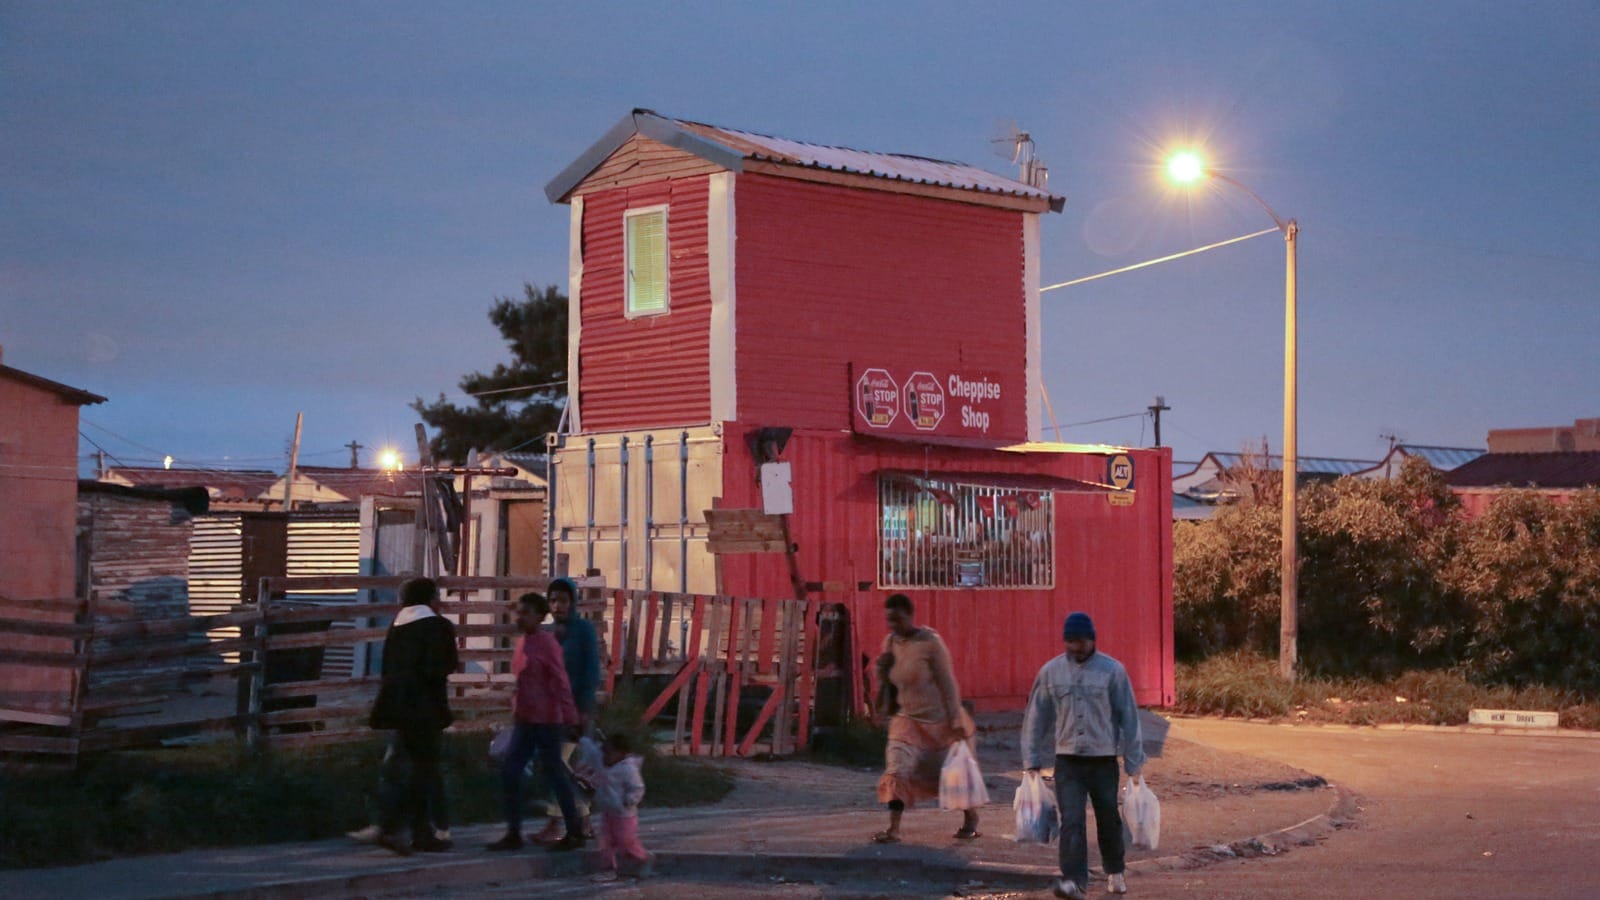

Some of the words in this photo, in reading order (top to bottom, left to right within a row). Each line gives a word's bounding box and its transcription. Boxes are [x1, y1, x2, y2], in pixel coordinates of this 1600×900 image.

[874, 390, 896, 402] STOP
[920, 393, 942, 405] STOP
[948, 374, 1001, 404] Cheppise
[961, 405, 990, 433] Shop
